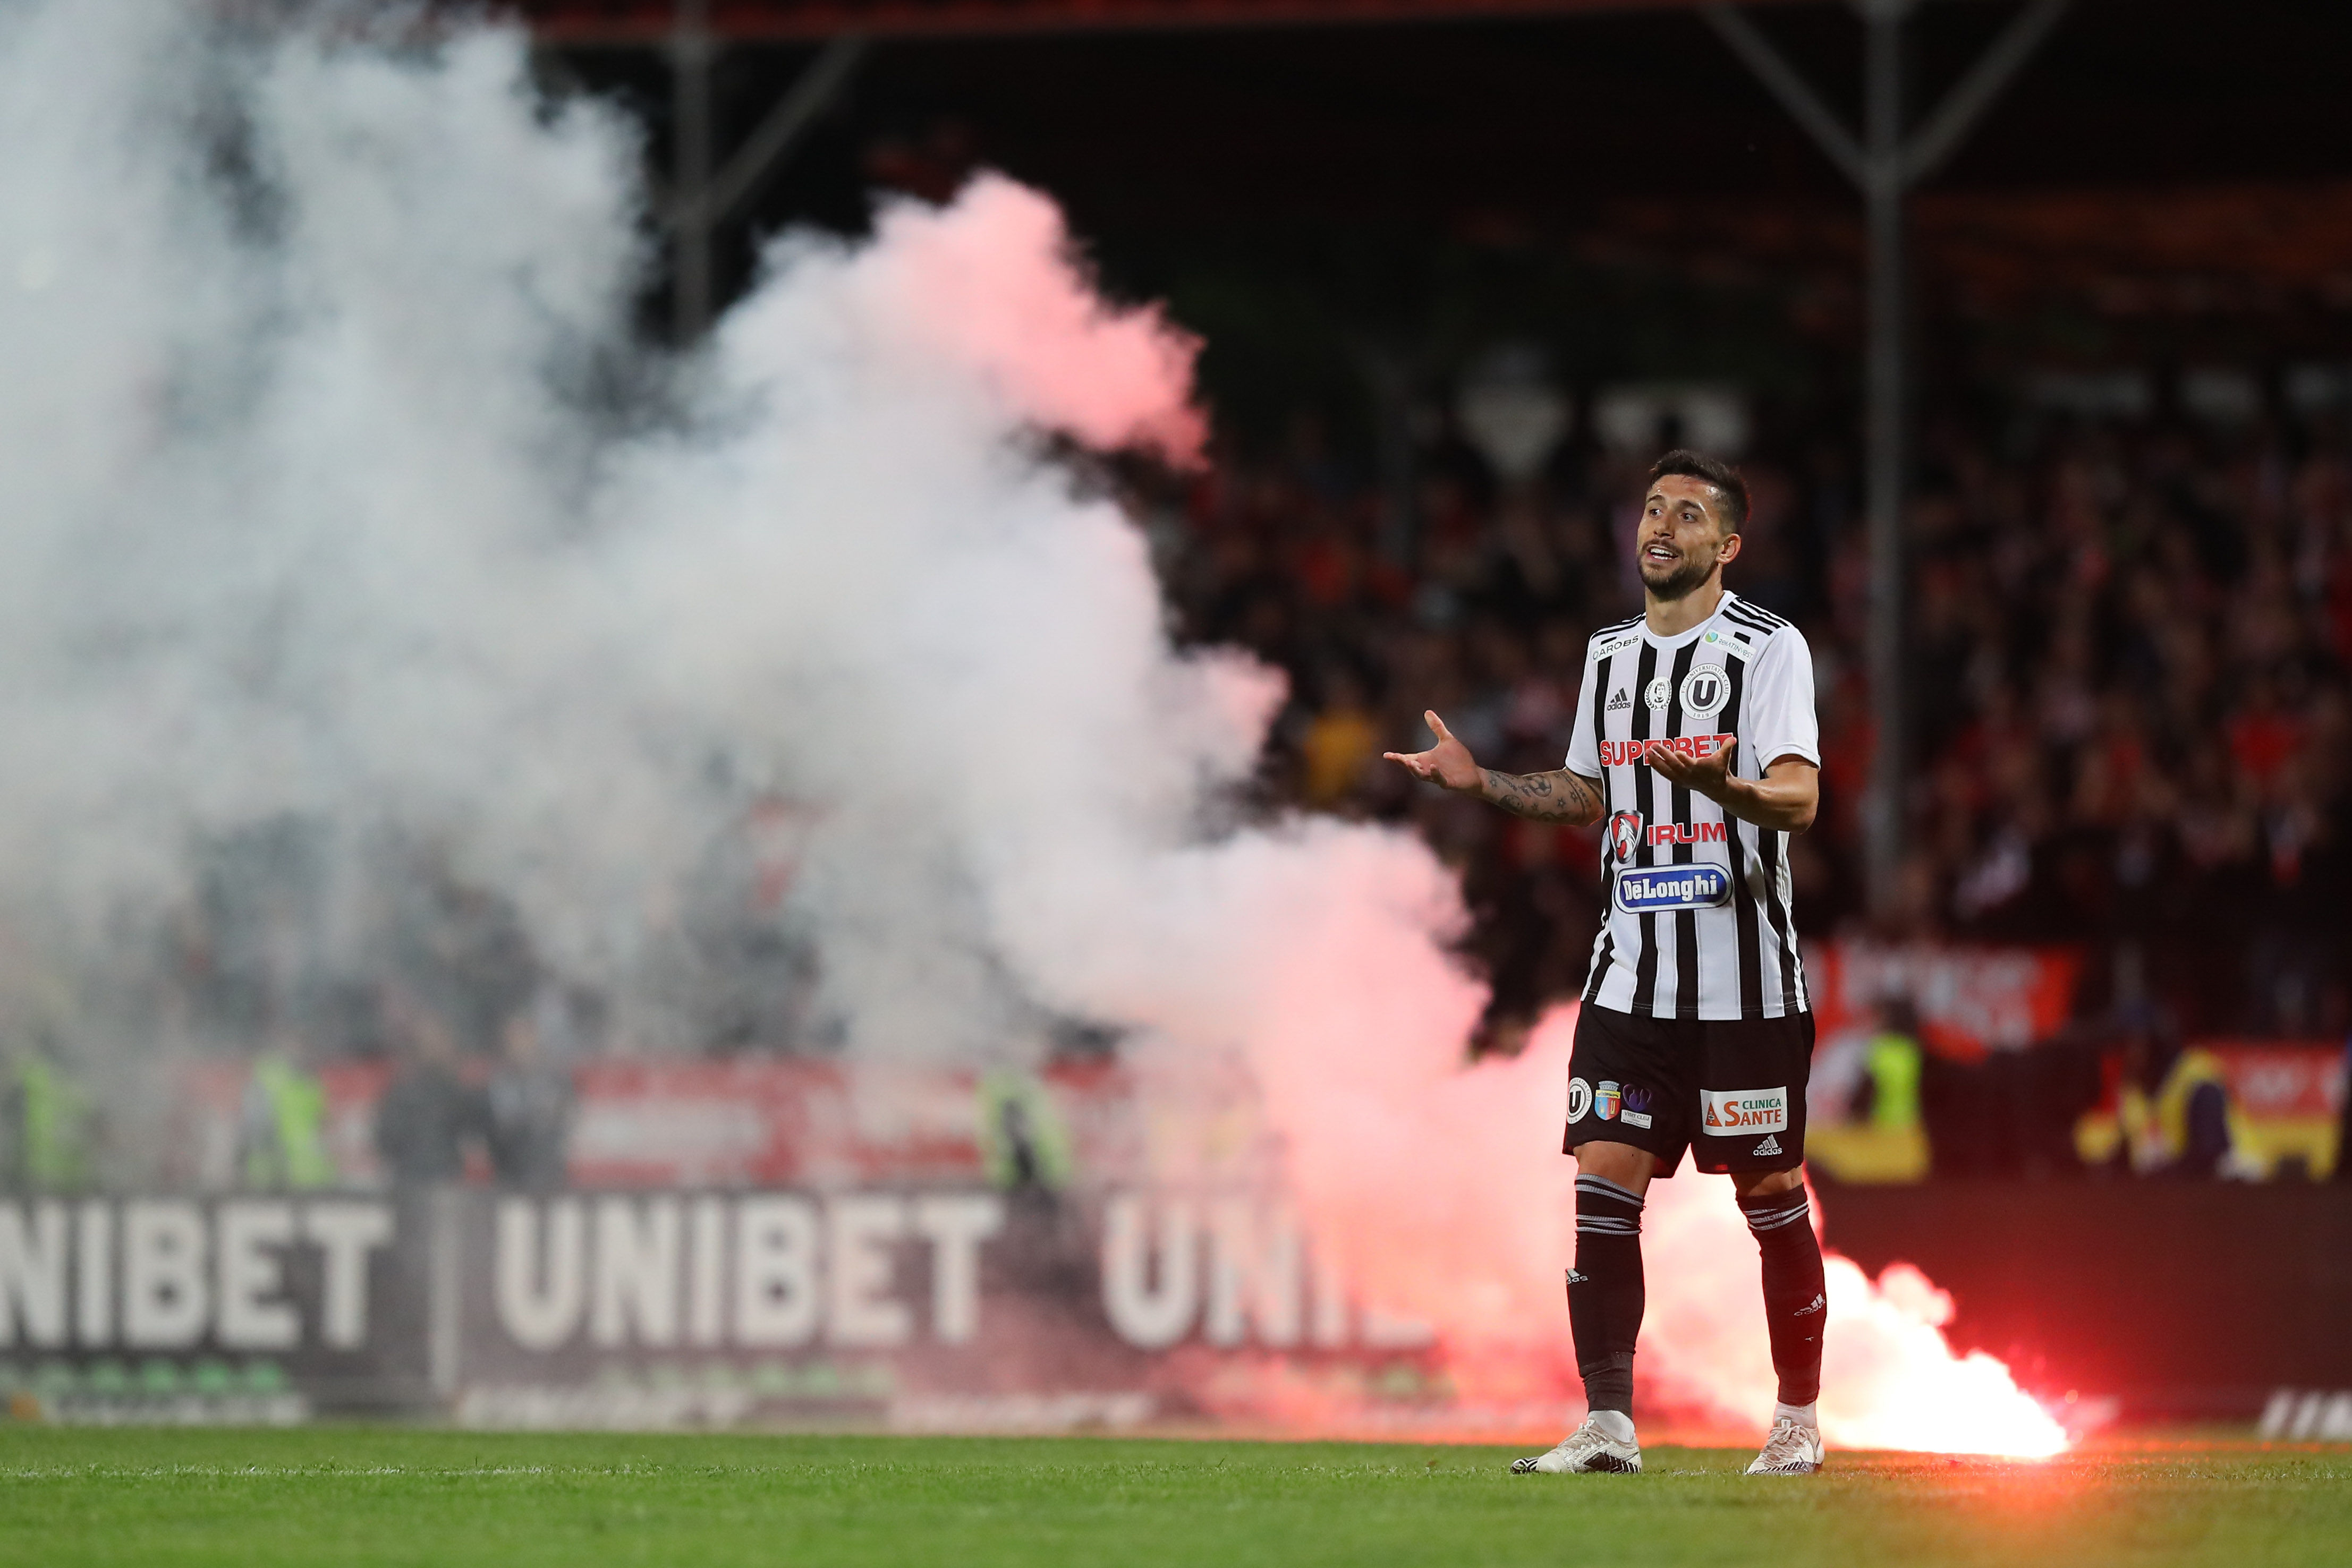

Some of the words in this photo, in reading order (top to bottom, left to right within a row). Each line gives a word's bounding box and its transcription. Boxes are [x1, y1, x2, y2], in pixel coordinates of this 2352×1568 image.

[1686, 665, 1726, 680] UNIVERSITATEA
[1693, 680, 1717, 706] U
[1607, 701, 1631, 711] adidas
[1648, 822, 1728, 846] IRUM
[1569, 1090, 1581, 1113] U
[1743, 1098, 1781, 1109] CLINICA
[495, 1192, 1003, 1351] UNIBET
